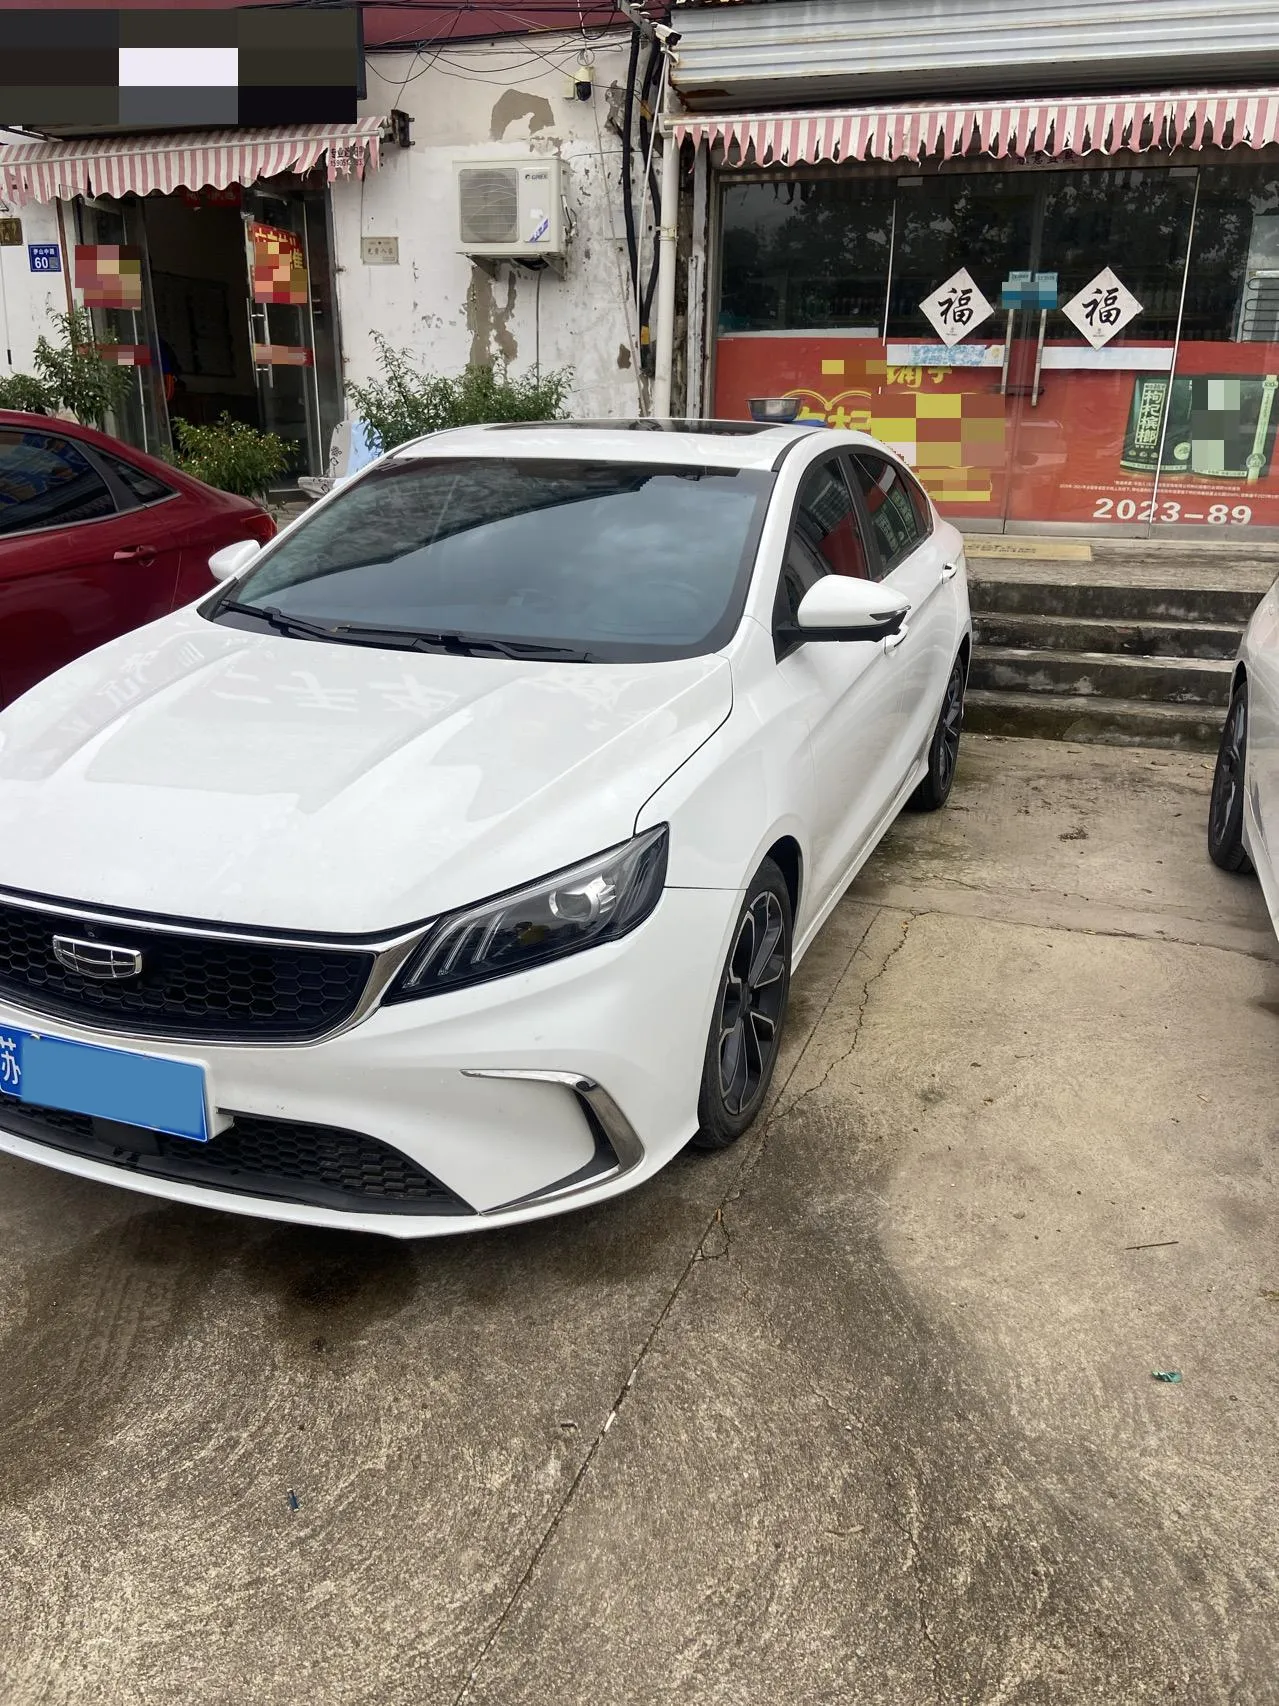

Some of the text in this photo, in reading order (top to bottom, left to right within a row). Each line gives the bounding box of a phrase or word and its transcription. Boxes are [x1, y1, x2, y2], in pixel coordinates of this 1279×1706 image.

[34, 257, 49, 269] 60
[938, 287, 974, 326] 福
[1082, 288, 1122, 327] 福
[1137, 390, 1163, 444] 枸杞槟榔
[1092, 498, 1252, 525] 2023-89
[0, 1036, 21, 1085] 苏
